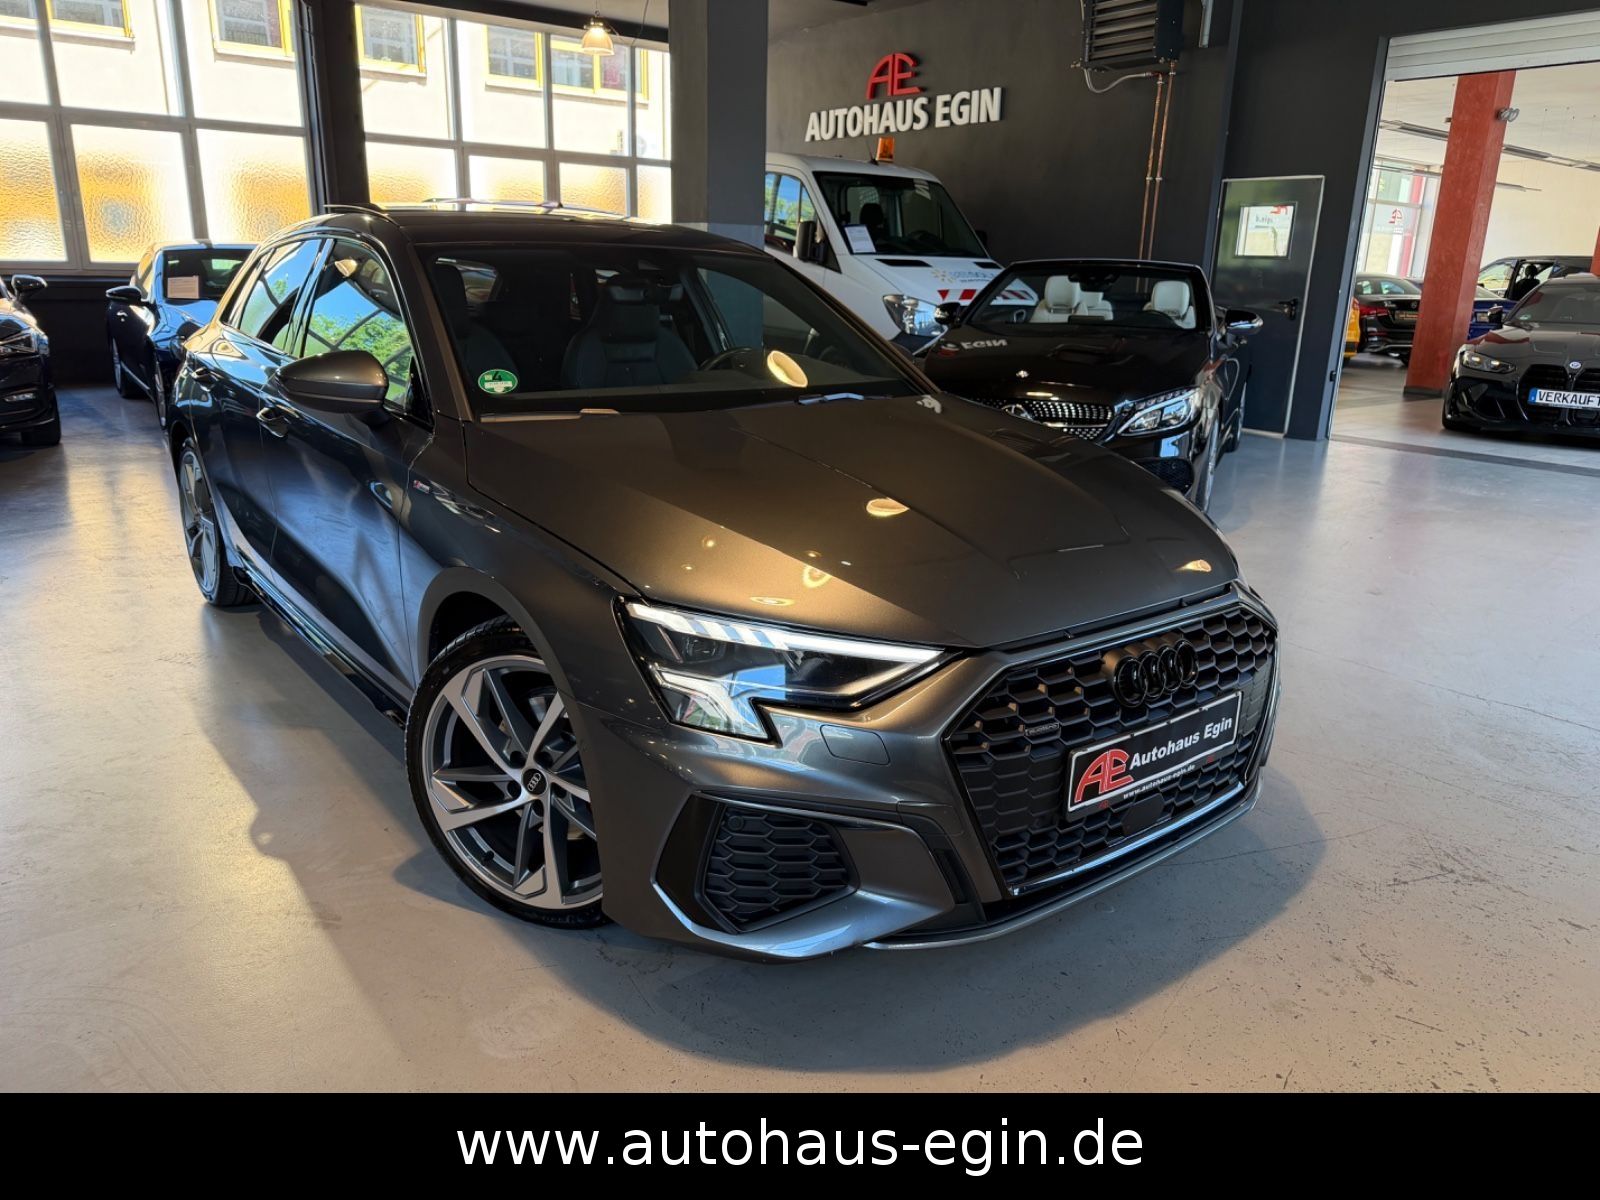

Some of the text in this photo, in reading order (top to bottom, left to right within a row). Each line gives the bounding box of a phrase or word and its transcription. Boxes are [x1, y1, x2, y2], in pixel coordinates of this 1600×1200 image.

[805, 87, 1002, 142] AUTOHAUS EGIN
[1129, 716, 1233, 771] Autohaus Egin
